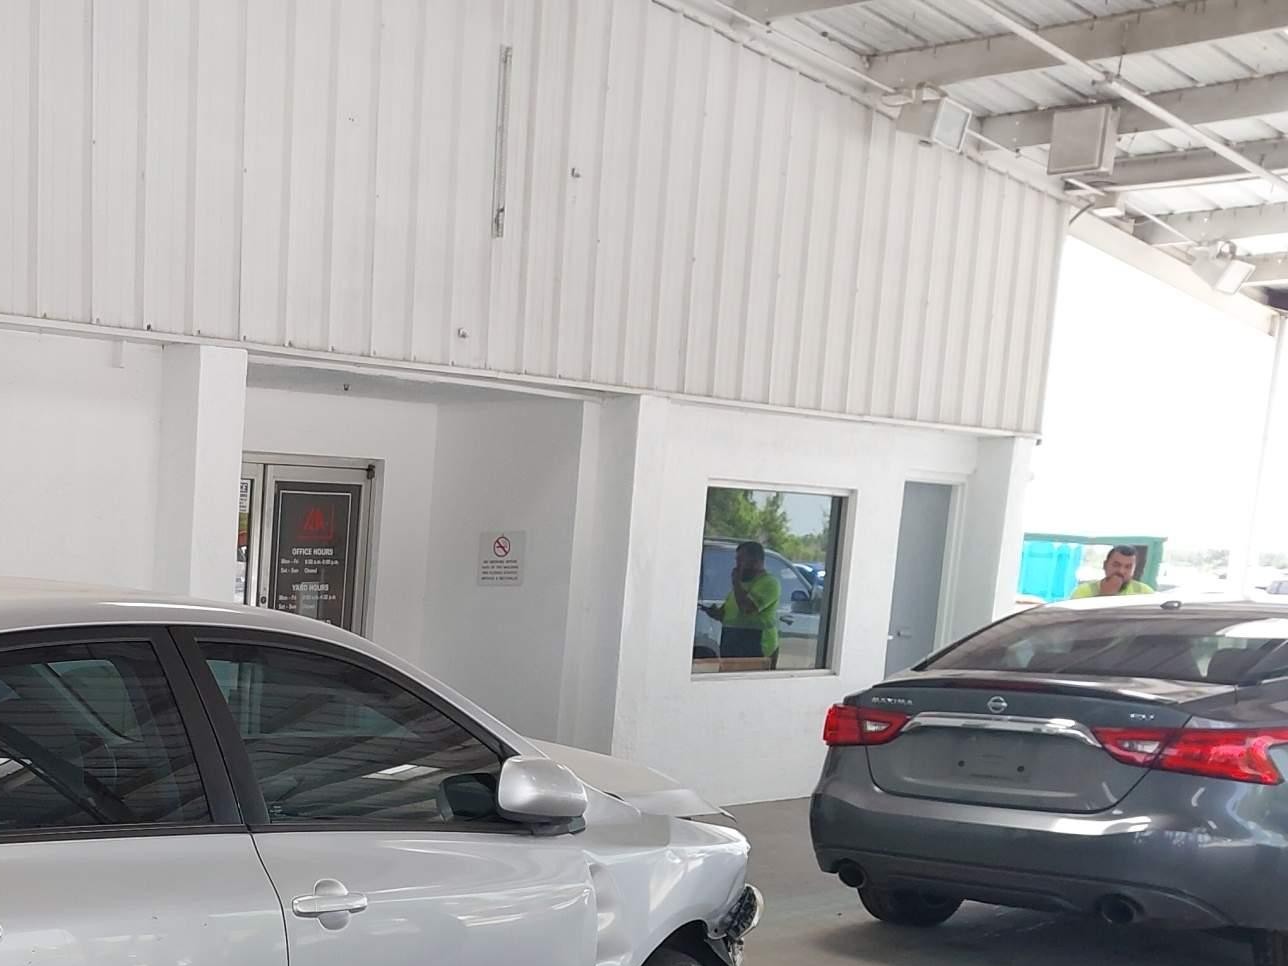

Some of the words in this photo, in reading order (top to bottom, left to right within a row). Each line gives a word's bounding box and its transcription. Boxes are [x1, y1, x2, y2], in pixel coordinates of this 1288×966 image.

[292, 547, 312, 556] OFFICE
[313, 548, 334, 556] HOURS
[292, 583, 308, 592] YARD
[309, 583, 329, 592] HOURS
